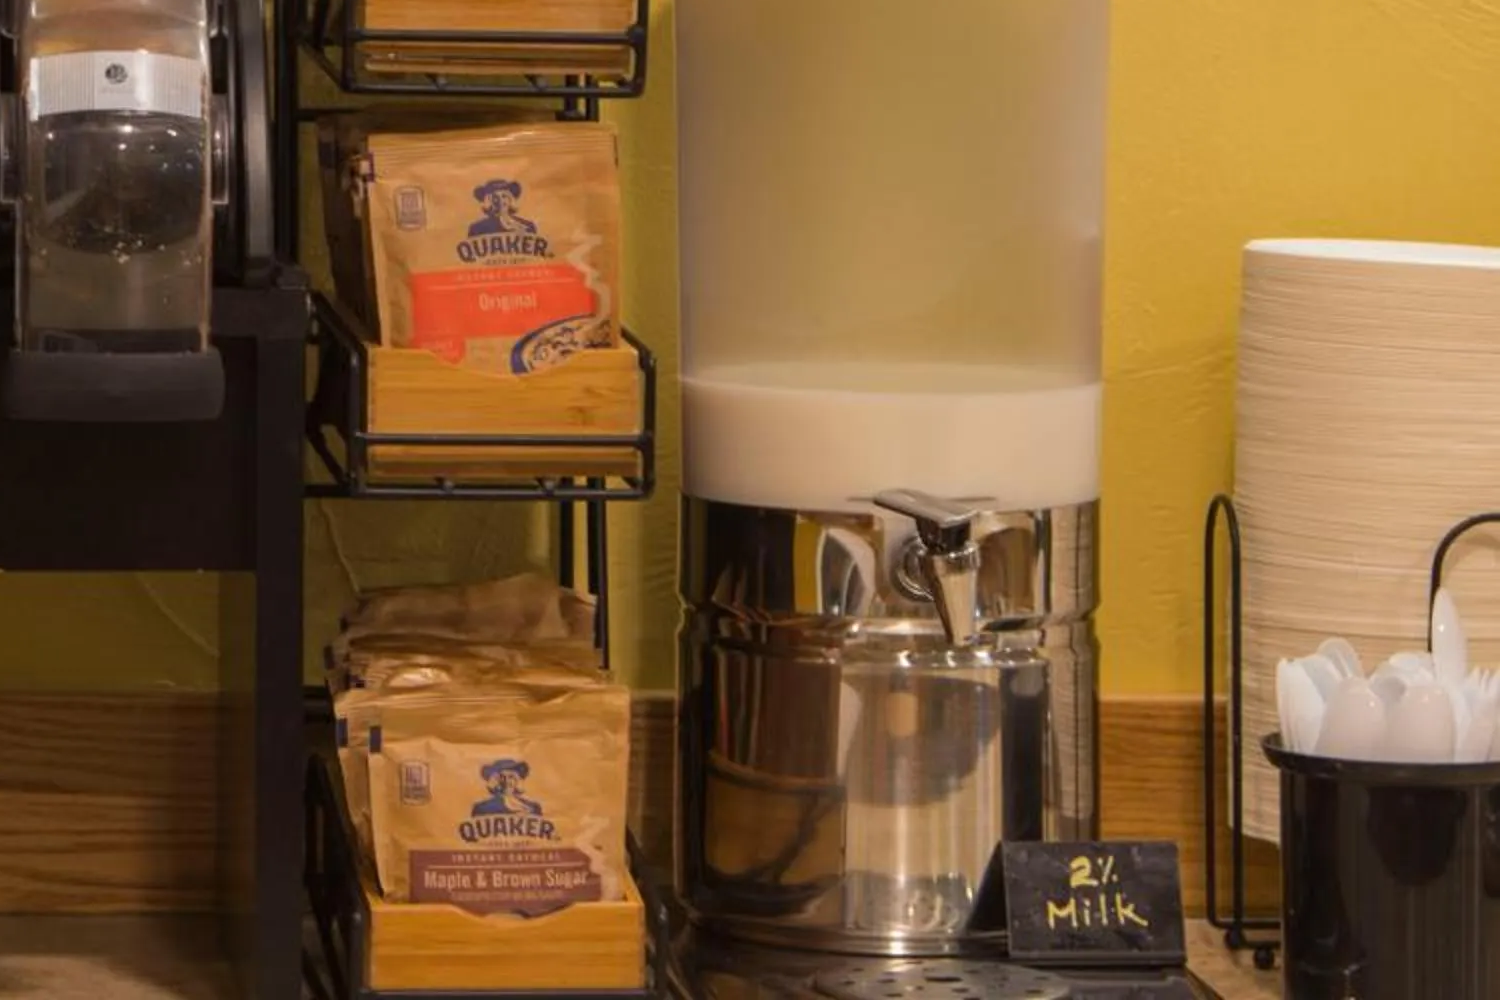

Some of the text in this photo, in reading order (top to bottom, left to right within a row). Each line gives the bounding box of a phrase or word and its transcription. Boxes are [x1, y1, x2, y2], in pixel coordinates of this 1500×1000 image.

[456, 235, 548, 263] QUAKER
[478, 291, 537, 314] Original
[458, 816, 555, 843] QUAKER
[424, 867, 589, 891] Maple & Brown Sugar
[1069, 855, 1119, 889] 2%
[1046, 892, 1149, 931] Milk
